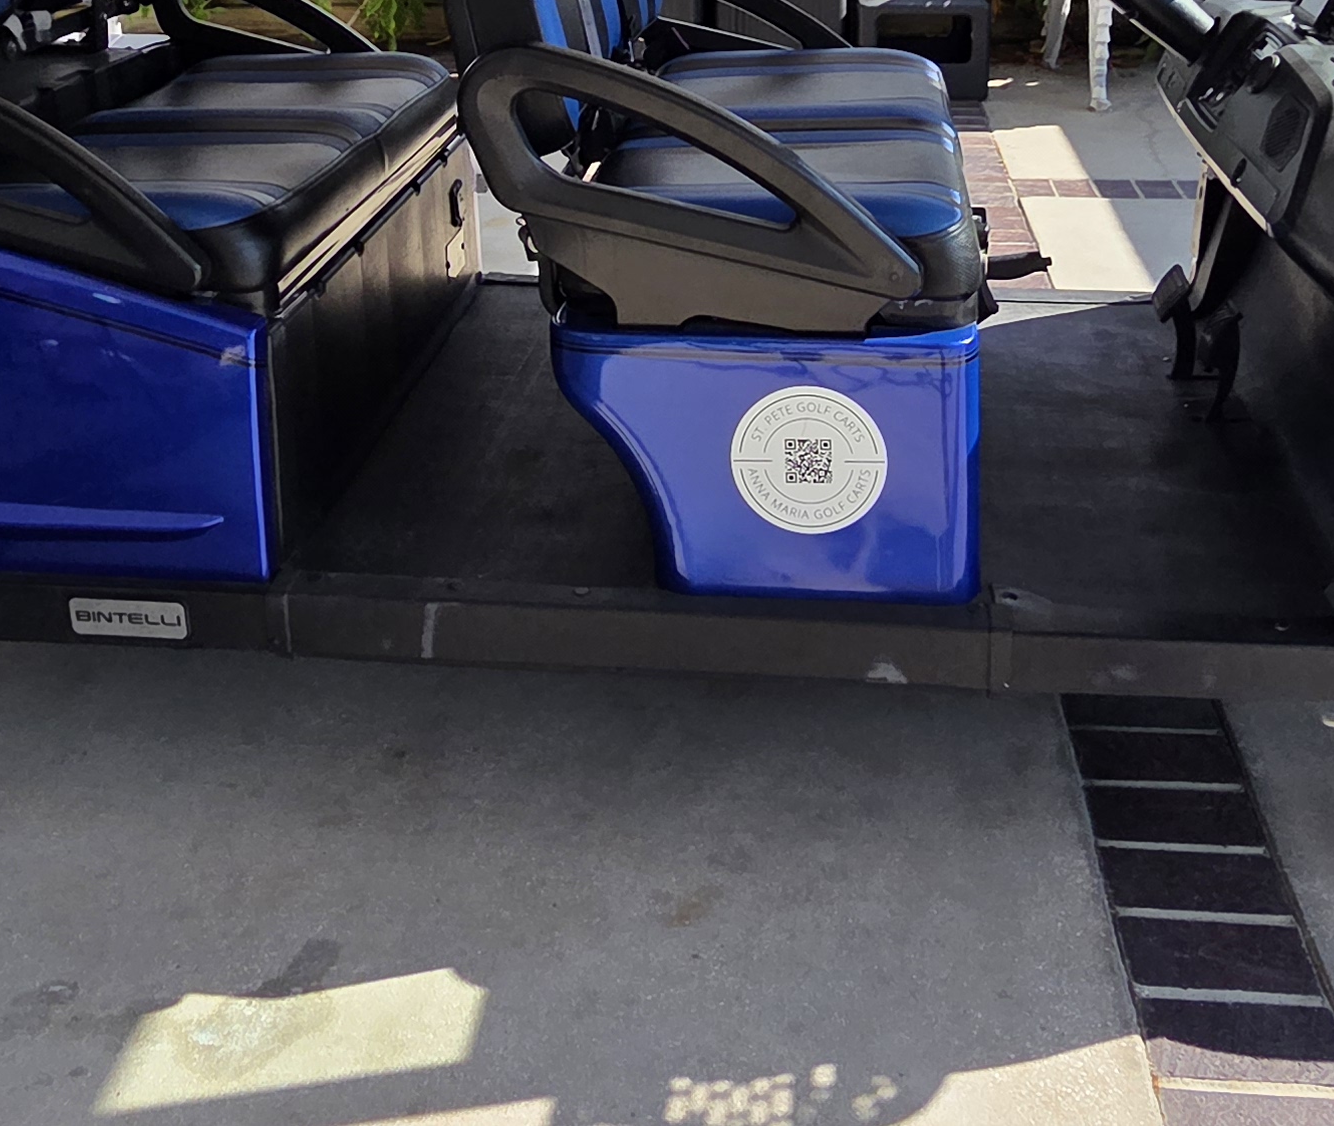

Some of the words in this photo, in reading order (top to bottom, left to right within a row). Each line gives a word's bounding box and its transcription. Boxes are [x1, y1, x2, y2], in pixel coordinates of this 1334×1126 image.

[764, 404, 793, 425] PETE
[796, 401, 832, 414] GOLF
[833, 411, 866, 443] CARTS
[748, 468, 771, 501] ANNA
[770, 498, 810, 520] MARIA
[813, 502, 846, 521] GOLF
[846, 469, 871, 504] CARTS
[75, 610, 182, 627] BINTELLI
